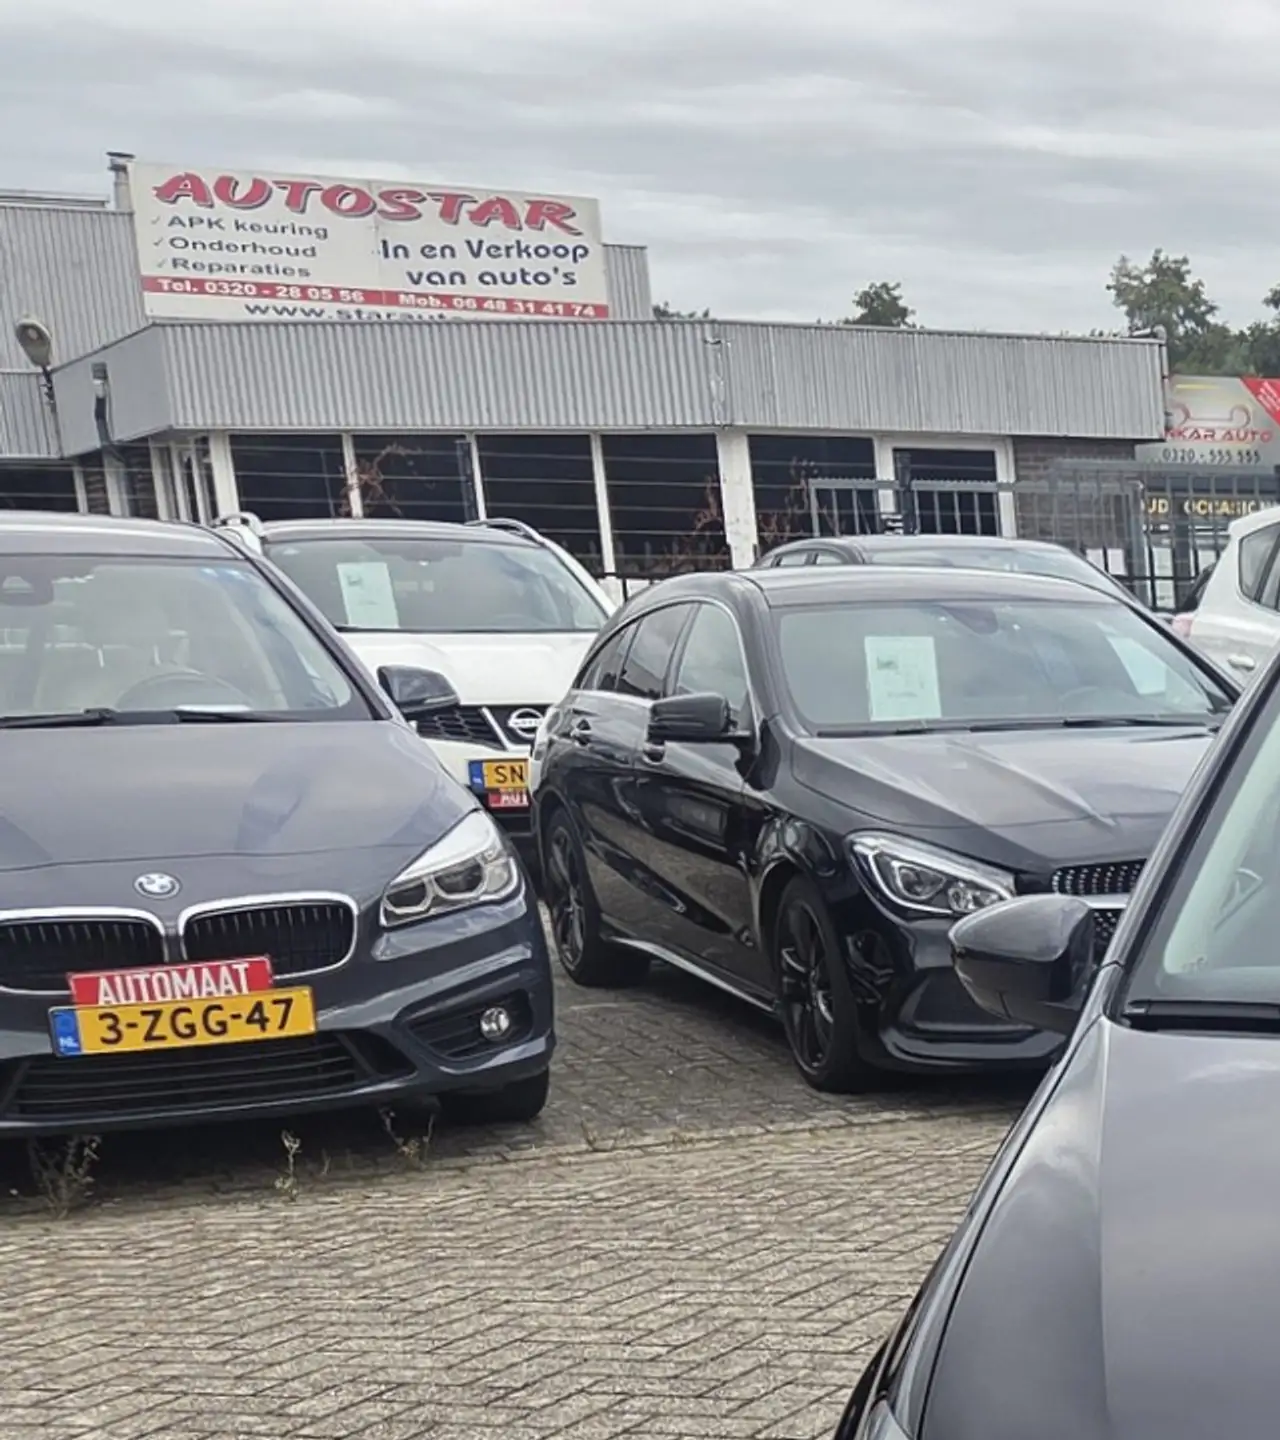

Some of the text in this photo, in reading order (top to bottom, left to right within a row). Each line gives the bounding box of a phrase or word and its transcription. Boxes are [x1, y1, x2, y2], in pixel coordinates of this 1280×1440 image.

[152, 171, 584, 237] AUTOSTAR
[167, 214, 329, 240] APK keuring
[168, 236, 317, 258] Onderhoud
[380, 238, 590, 264] In en Verkoop
[171, 256, 312, 278] Reparaties
[406, 266, 577, 287] van auto's
[157, 278, 199, 293] Tel.
[204, 280, 256, 297] 0320
[275, 285, 302, 300] 28
[306, 286, 333, 302] 05
[338, 288, 366, 304] 56
[398, 292, 448, 309] Mob.
[452, 295, 477, 310] 06
[570, 303, 597, 318] 74
[98, 962, 250, 1005] AUTOMAAT
[98, 997, 294, 1046] 3-ZGG-47
